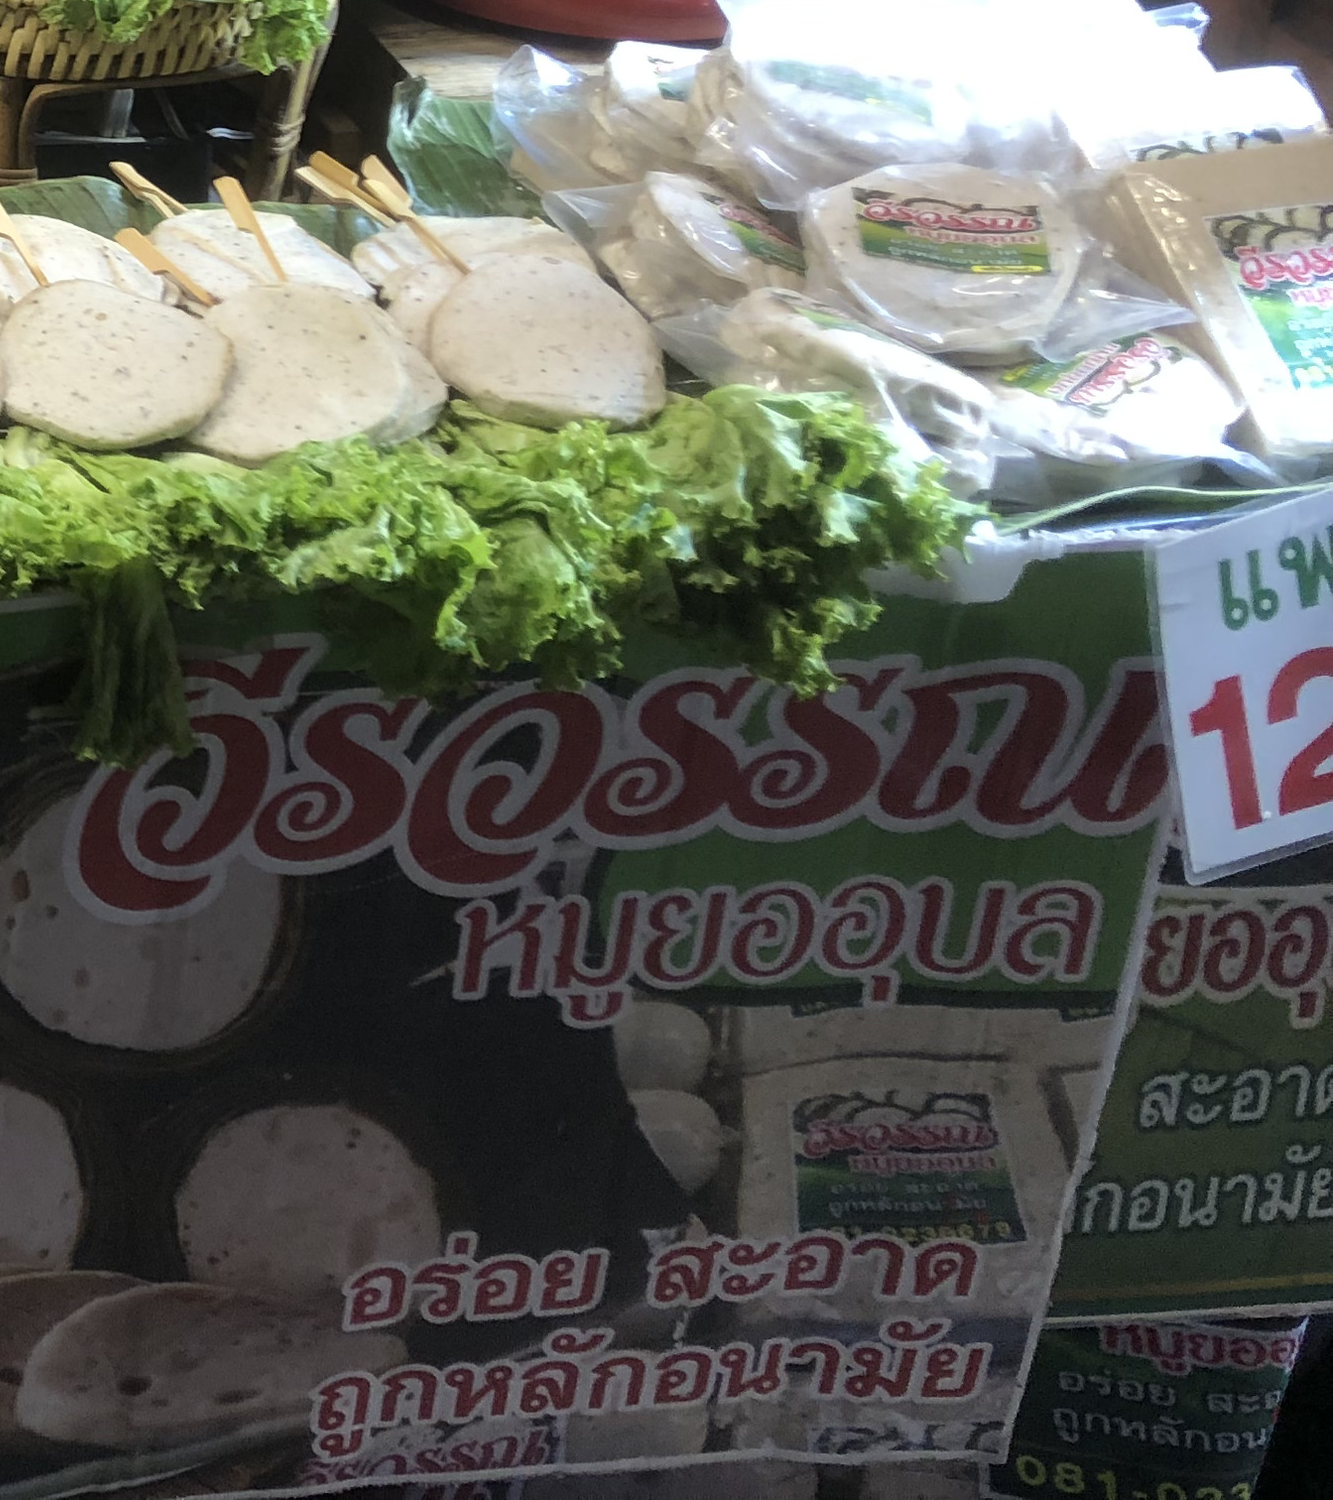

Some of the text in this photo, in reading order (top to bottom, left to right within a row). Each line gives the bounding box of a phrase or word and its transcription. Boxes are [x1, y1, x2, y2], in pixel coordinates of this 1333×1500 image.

[453, 880, 1098, 1026] หมูยออุบล
[347, 1233, 981, 1326] อร่อย สะอาด
[315, 1320, 989, 1457] ถูกหลักอนามัย
